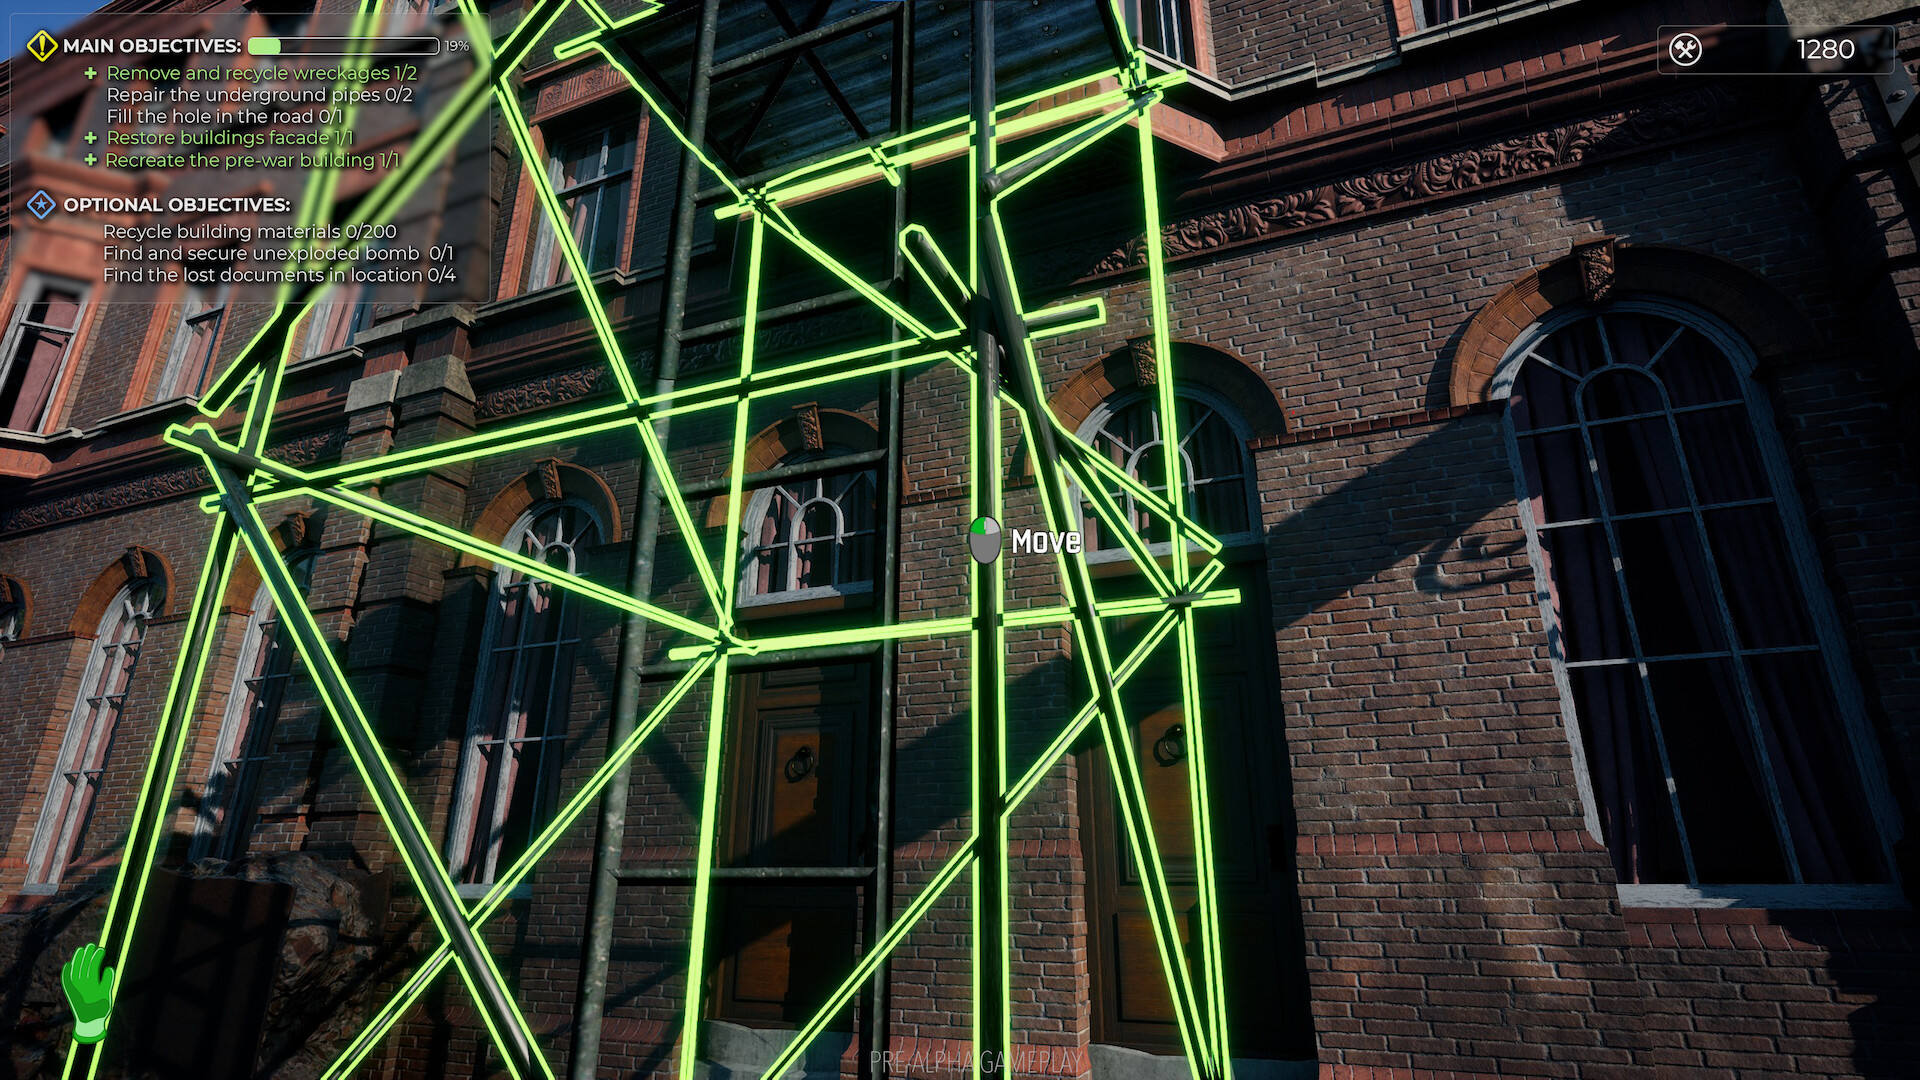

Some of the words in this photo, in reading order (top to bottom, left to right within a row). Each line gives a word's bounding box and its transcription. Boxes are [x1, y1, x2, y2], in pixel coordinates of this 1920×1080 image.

[63, 39, 114, 53] MAIN
[120, 39, 242, 54] OBJECTIVES:
[445, 41, 470, 52] 19%
[1797, 39, 1855, 60] 1280
[107, 67, 182, 80] Remove
[186, 66, 221, 80] and
[225, 66, 288, 84] recycle
[293, 66, 390, 84] wreckages
[394, 66, 417, 81] 1/2
[107, 88, 166, 105] Repair
[170, 88, 200, 102] the
[205, 88, 326, 105] underground
[332, 88, 380, 105] pipes
[385, 88, 412, 103] 0/2
[107, 109, 132, 123] Fill
[136, 109, 167, 123] the
[172, 109, 212, 123] hole
[216, 109, 232, 123] in
[237, 109, 268, 123] the
[273, 109, 314, 123] road
[319, 109, 343, 124] 0/1
[107, 131, 175, 145] Restore
[181, 130, 265, 148] buildings
[269, 130, 330, 145] facade
[335, 131, 354, 146] 1/1
[106, 153, 184, 168] Recreate
[189, 152, 220, 168] the
[225, 155, 295, 170] pre-war
[300, 152, 375, 170] building
[380, 153, 399, 168] 1/1
[64, 198, 163, 212] OPTIONAL
[168, 198, 291, 212] OBJECTIVES:
[104, 225, 173, 242] Recycle
[178, 224, 251, 242] building
[257, 224, 340, 239] materials
[346, 224, 397, 239] 0/200
[104, 246, 143, 261] Find
[148, 246, 183, 261] and
[188, 248, 248, 261] secure
[254, 246, 360, 264] unexploded
[366, 246, 419, 261] bomb
[429, 246, 454, 261] 0/1
[104, 268, 146, 283] Find
[151, 268, 179, 283] the
[183, 268, 212, 283] lost
[217, 268, 325, 283] documents
[330, 268, 345, 283] in
[350, 268, 423, 283] location
[427, 268, 456, 284] 0/4
[1012, 528, 1082, 554] Move
